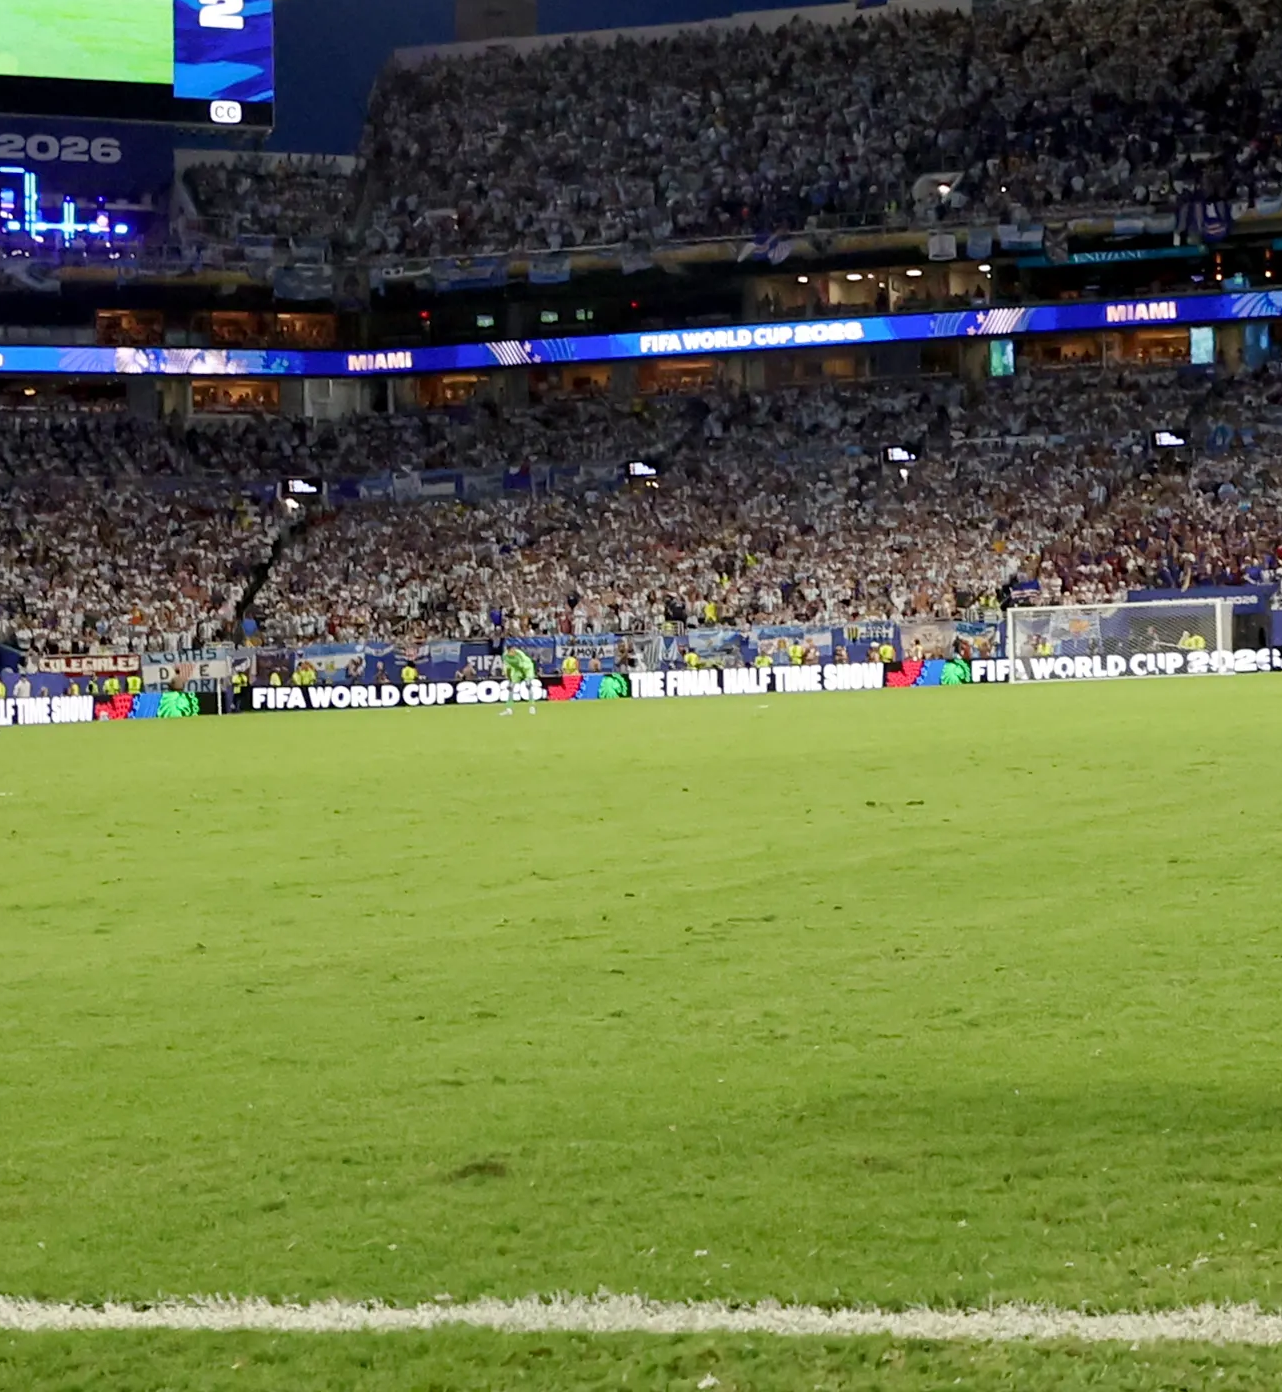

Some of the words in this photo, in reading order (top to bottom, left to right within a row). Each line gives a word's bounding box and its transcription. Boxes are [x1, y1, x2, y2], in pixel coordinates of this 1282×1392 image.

[213, 105, 240, 120] CC
[1106, 301, 1177, 323] MIAMI
[639, 333, 682, 353] FIFA
[682, 329, 752, 350] WORLD
[753, 326, 793, 345] CUP
[794, 322, 864, 343] 2026
[348, 351, 413, 371] MIAMI
[467, 654, 503, 671] FIFA
[971, 658, 1027, 683] FIFA
[1029, 655, 1127, 679] WORLD
[1129, 652, 1184, 676] CUP
[629, 671, 665, 698] THE
[667, 668, 721, 697] FINAL
[723, 666, 771, 695] HALF
[772, 664, 822, 692] TIME
[823, 662, 885, 690] SHOW
[17, 697, 51, 725] TIME
[51, 695, 94, 722] SHOW
[252, 686, 307, 710] FIFA
[307, 685, 401, 708] WORLD
[402, 683, 454, 705] CUP
